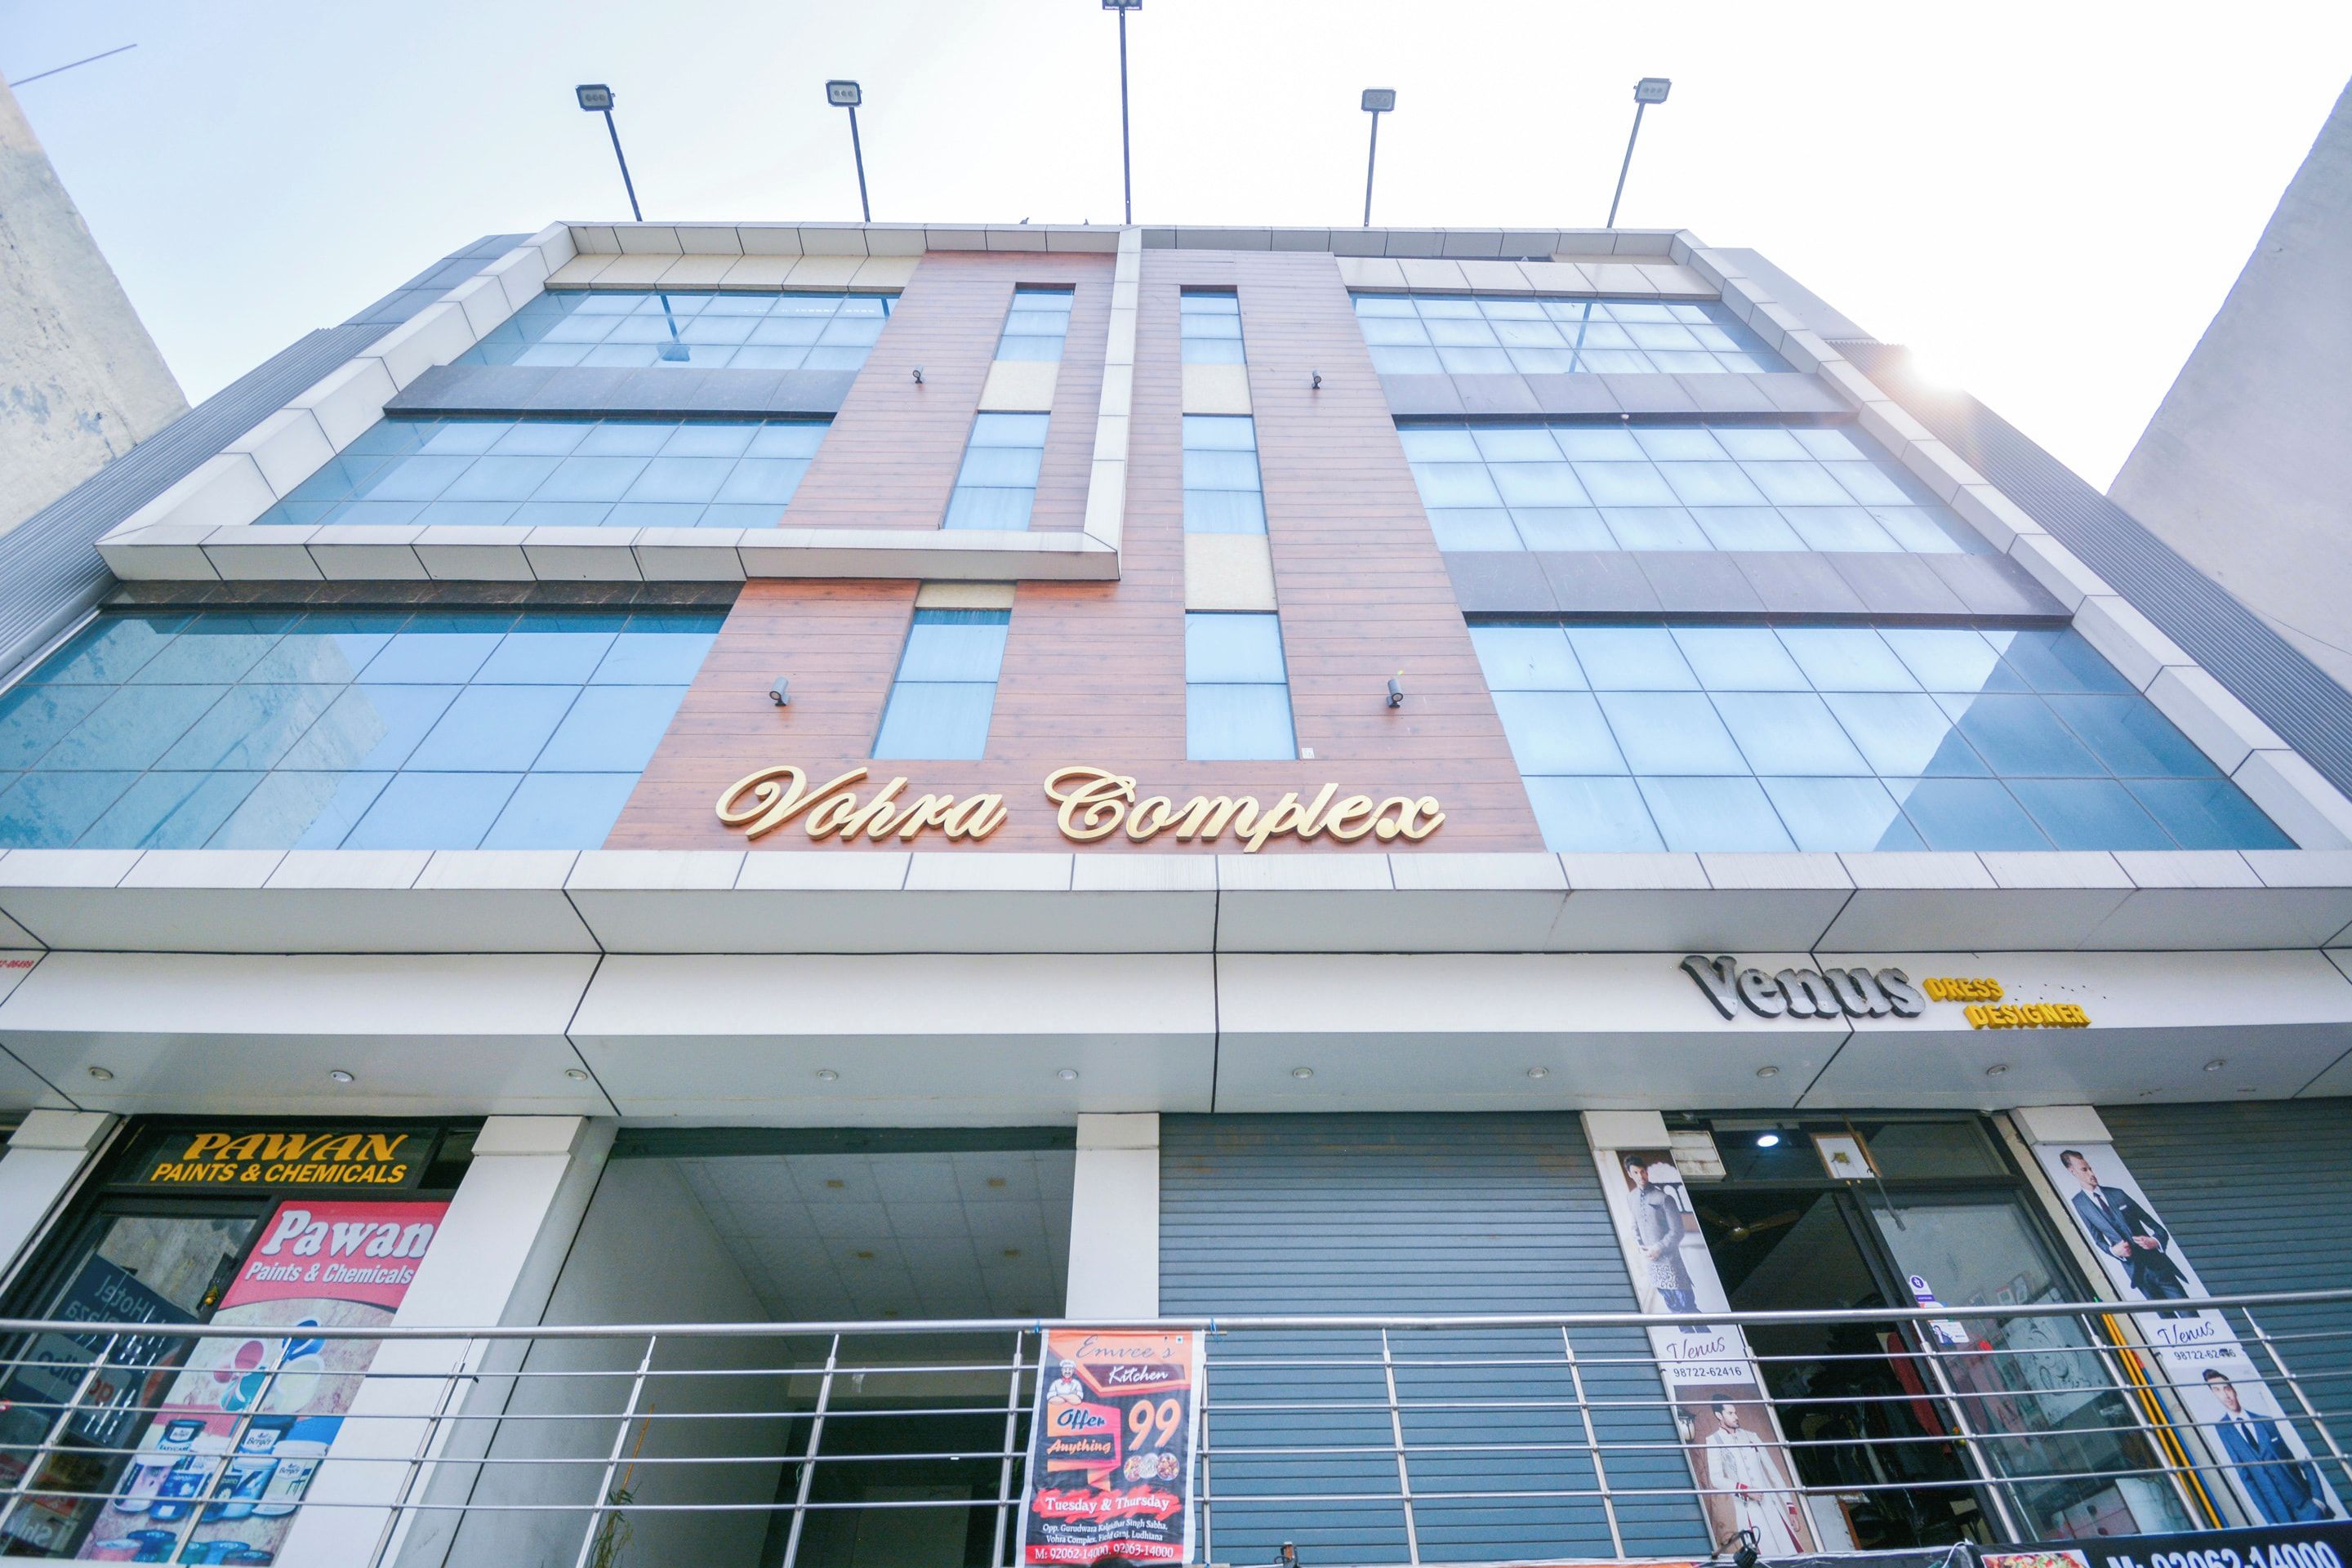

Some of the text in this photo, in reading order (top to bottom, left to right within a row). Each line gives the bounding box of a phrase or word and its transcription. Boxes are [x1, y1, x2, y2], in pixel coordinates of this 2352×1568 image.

[715, 765, 1446, 853] Vohra Complex
[1681, 955, 1927, 1021] Venus
[1922, 978, 2004, 1002] DRESS
[1964, 1003, 2091, 1029] DESIGNER
[183, 1133, 408, 1161] PAWAN
[150, 1163, 408, 1183] PAINTS & CHEMICALS
[261, 1209, 434, 1258] Pawan
[245, 1261, 415, 1285] Paints & Chemicals
[2157, 1321, 2215, 1348] Venus
[1667, 1336, 1726, 1363] Venus
[2173, 1348, 2236, 1361] 98722-626
[1109, 1365, 1169, 1384] Kitchen
[1673, 1366, 1742, 1378] 98722-62416
[1057, 1408, 1107, 1430] Offer
[1128, 1398, 1182, 1451] 99
[247, 1437, 272, 1448] Berger
[1046, 1438, 1111, 1455] Anything
[1045, 1494, 1170, 1513] Tuesday & Thursday
[1042, 1523, 1059, 1533] Opp.
[1060, 1523, 1098, 1533] Gurudwara
[1125, 1518, 1145, 1530] Singh
[1046, 1535, 1066, 1544] Vohra
[1098, 1531, 1112, 1542] Field
[1131, 1530, 1164, 1541] Ludhiana
[1034, 1548, 1048, 1560] M:
